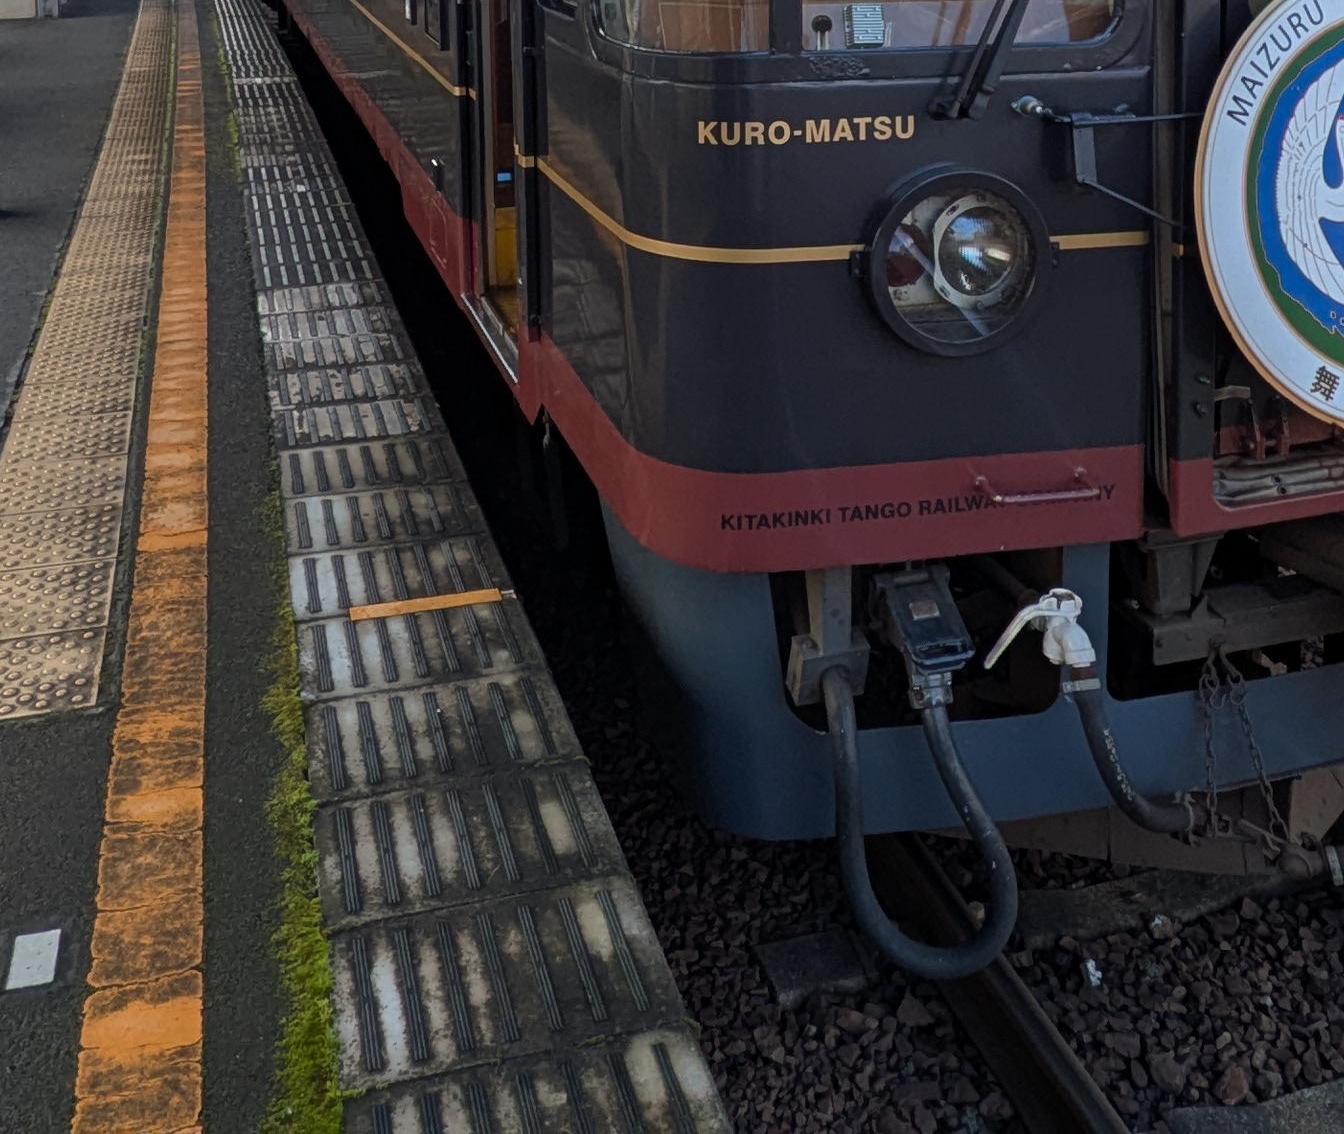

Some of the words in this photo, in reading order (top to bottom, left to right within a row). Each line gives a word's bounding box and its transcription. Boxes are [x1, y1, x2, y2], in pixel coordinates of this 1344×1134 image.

[697, 115, 916, 146] KURO-MATSU
[720, 508, 832, 532] KITAKINKI
[839, 502, 913, 524] TANGO
